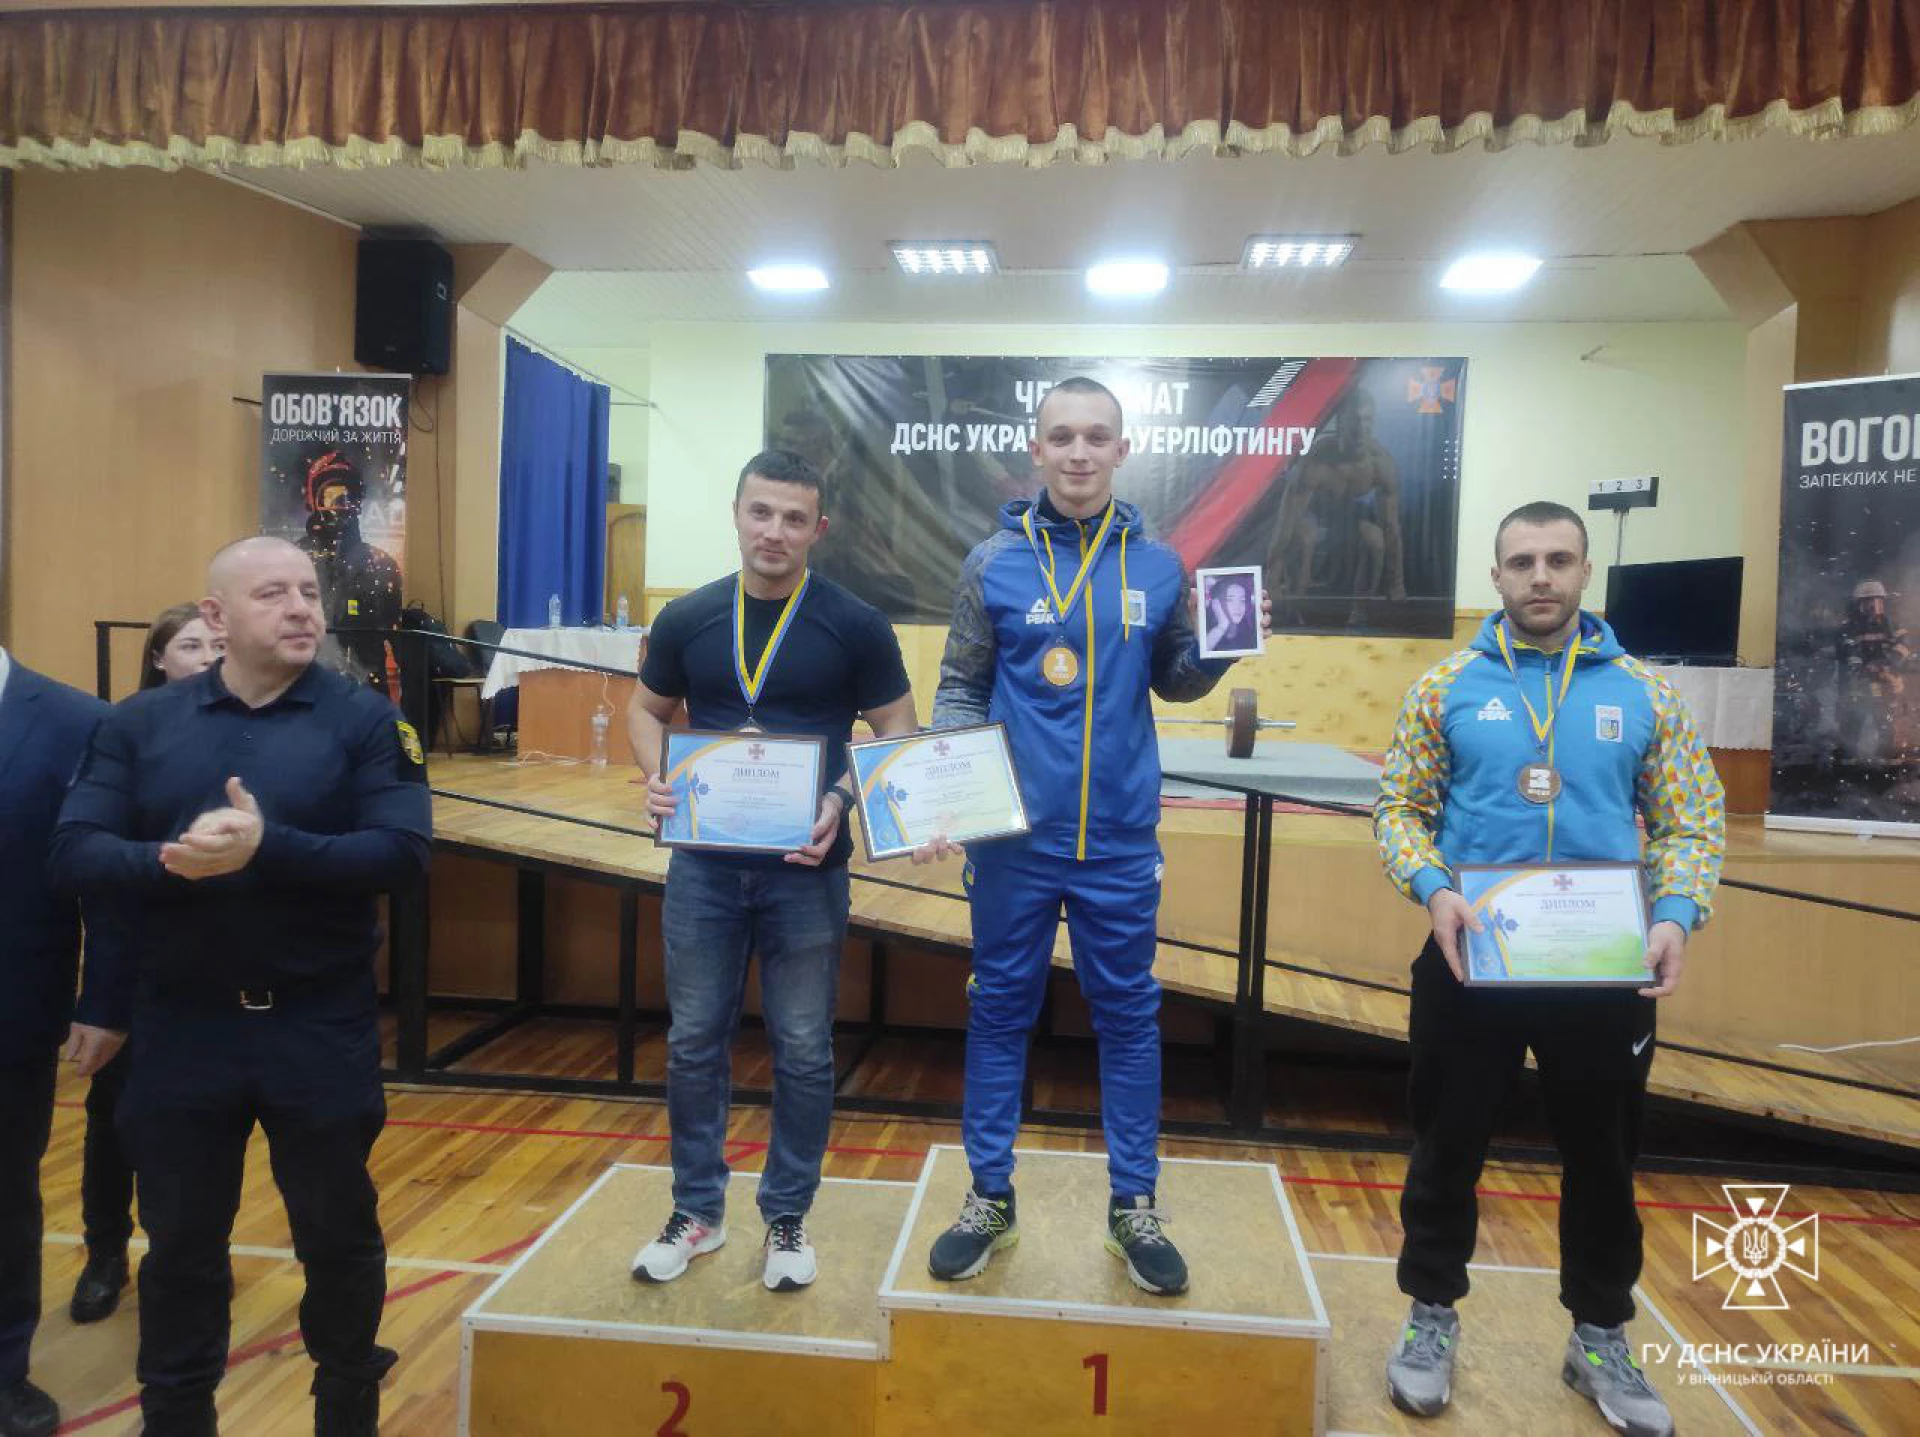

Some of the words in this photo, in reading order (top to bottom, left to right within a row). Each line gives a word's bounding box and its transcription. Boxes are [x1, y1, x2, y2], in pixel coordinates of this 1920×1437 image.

[270, 393, 403, 428] ОБОВ'ЯЗОК
[1015, 380, 1189, 415] ЧЕНАТ
[270, 428, 340, 444] ДОРОЖЧИЙ
[342, 431, 358, 443] ЗА
[361, 431, 402, 445] ЖИТТЯ
[890, 422, 961, 455] ДСНС
[965, 417, 1037, 452] УКРАЇ
[1123, 424, 1317, 456] АУЕРЛІФТИНГУ
[1616, 481, 1623, 491] 2
[1635, 479, 1643, 490] 3
[1799, 470, 1888, 489] ЗАПЕКЛИХ
[1893, 468, 1918, 484] НЕ
[1082, 1354, 1108, 1416] 1
[656, 1382, 691, 1437] 2
